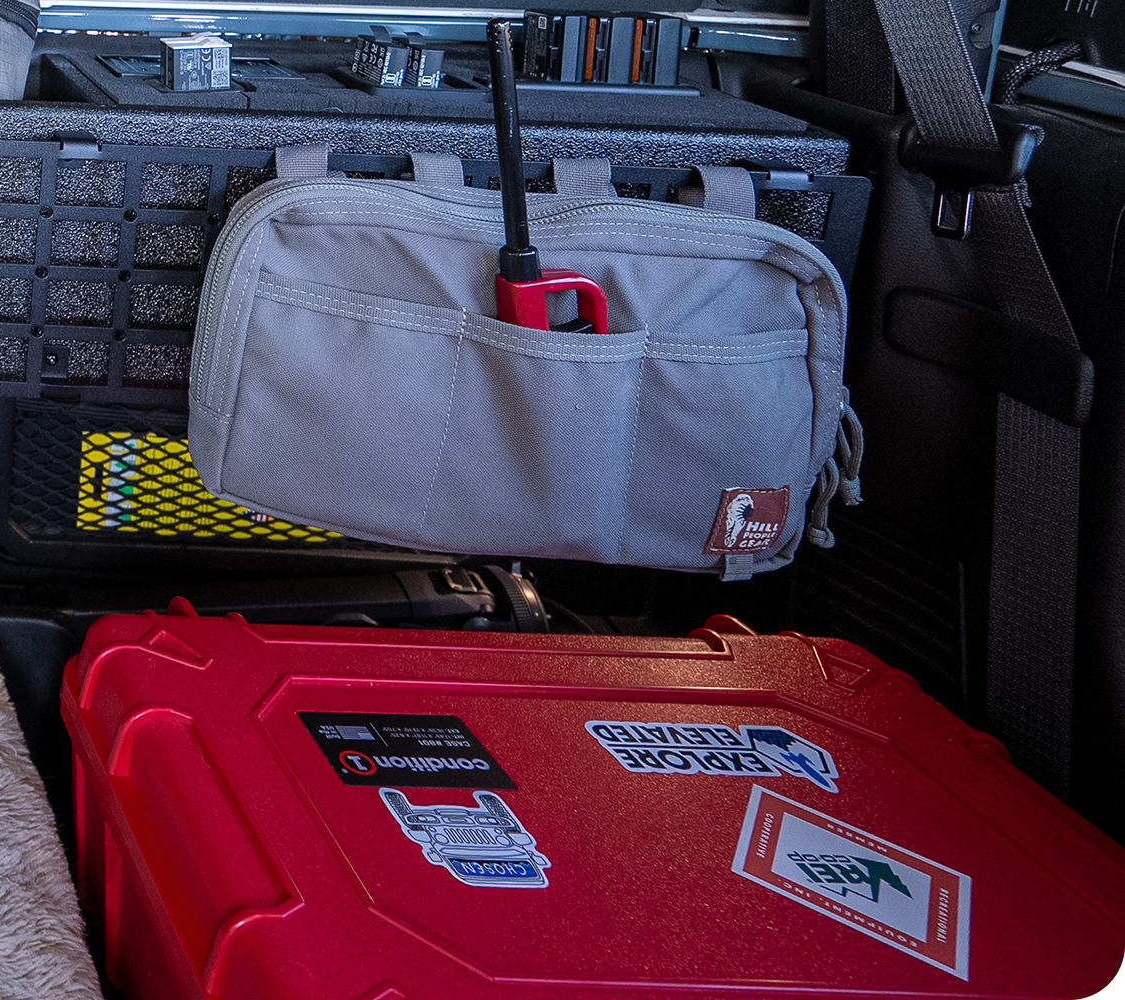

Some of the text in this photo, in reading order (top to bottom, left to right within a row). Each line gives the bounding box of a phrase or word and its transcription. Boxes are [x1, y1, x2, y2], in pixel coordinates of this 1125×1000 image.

[746, 521, 779, 532] HILL
[739, 539, 771, 548] GEAR
[445, 740, 472, 749] CASE
[591, 725, 745, 747] ELEVATED
[372, 755, 492, 773] condition
[613, 748, 775, 773] EXPLORE
[756, 812, 774, 859] COOPERATIVE
[826, 822, 888, 854] MEMBER
[460, 860, 527, 877] CHOSEN
[796, 862, 869, 885] REI
[936, 887, 950, 944] RECREATIONAL
